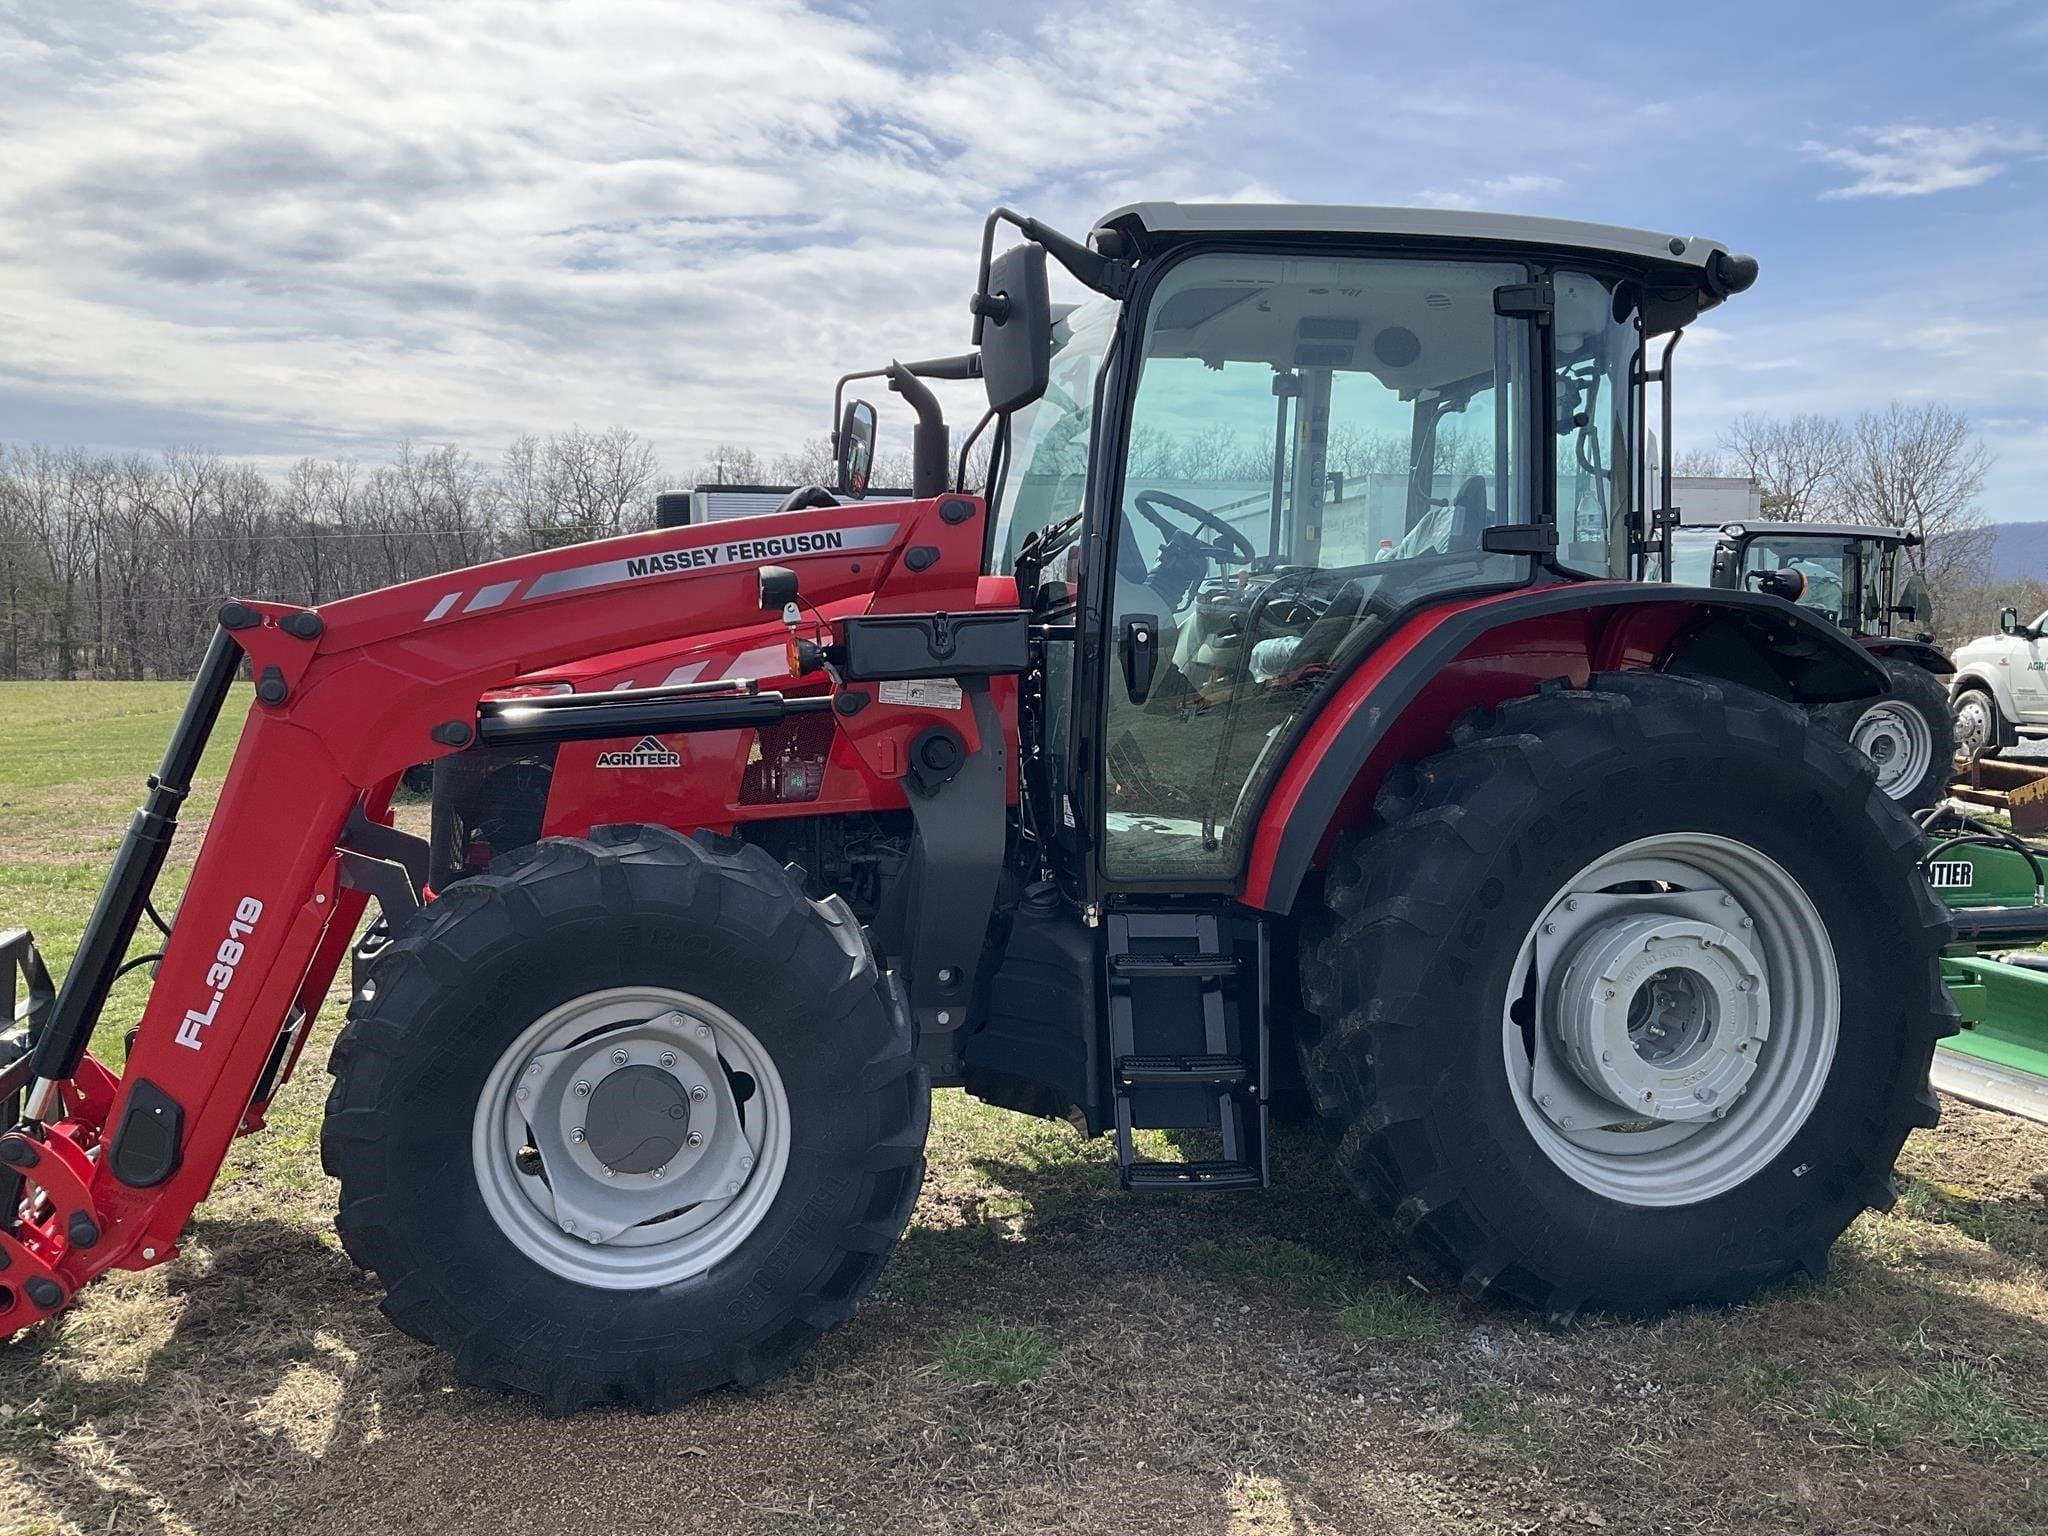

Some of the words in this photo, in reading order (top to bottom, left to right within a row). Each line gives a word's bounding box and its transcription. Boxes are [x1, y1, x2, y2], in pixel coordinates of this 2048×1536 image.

[627, 547, 718, 577] MASSEY
[727, 532, 842, 561] FERGUSON
[597, 753, 678, 766] AGRITEER
[175, 896, 263, 1050] FL.3819
